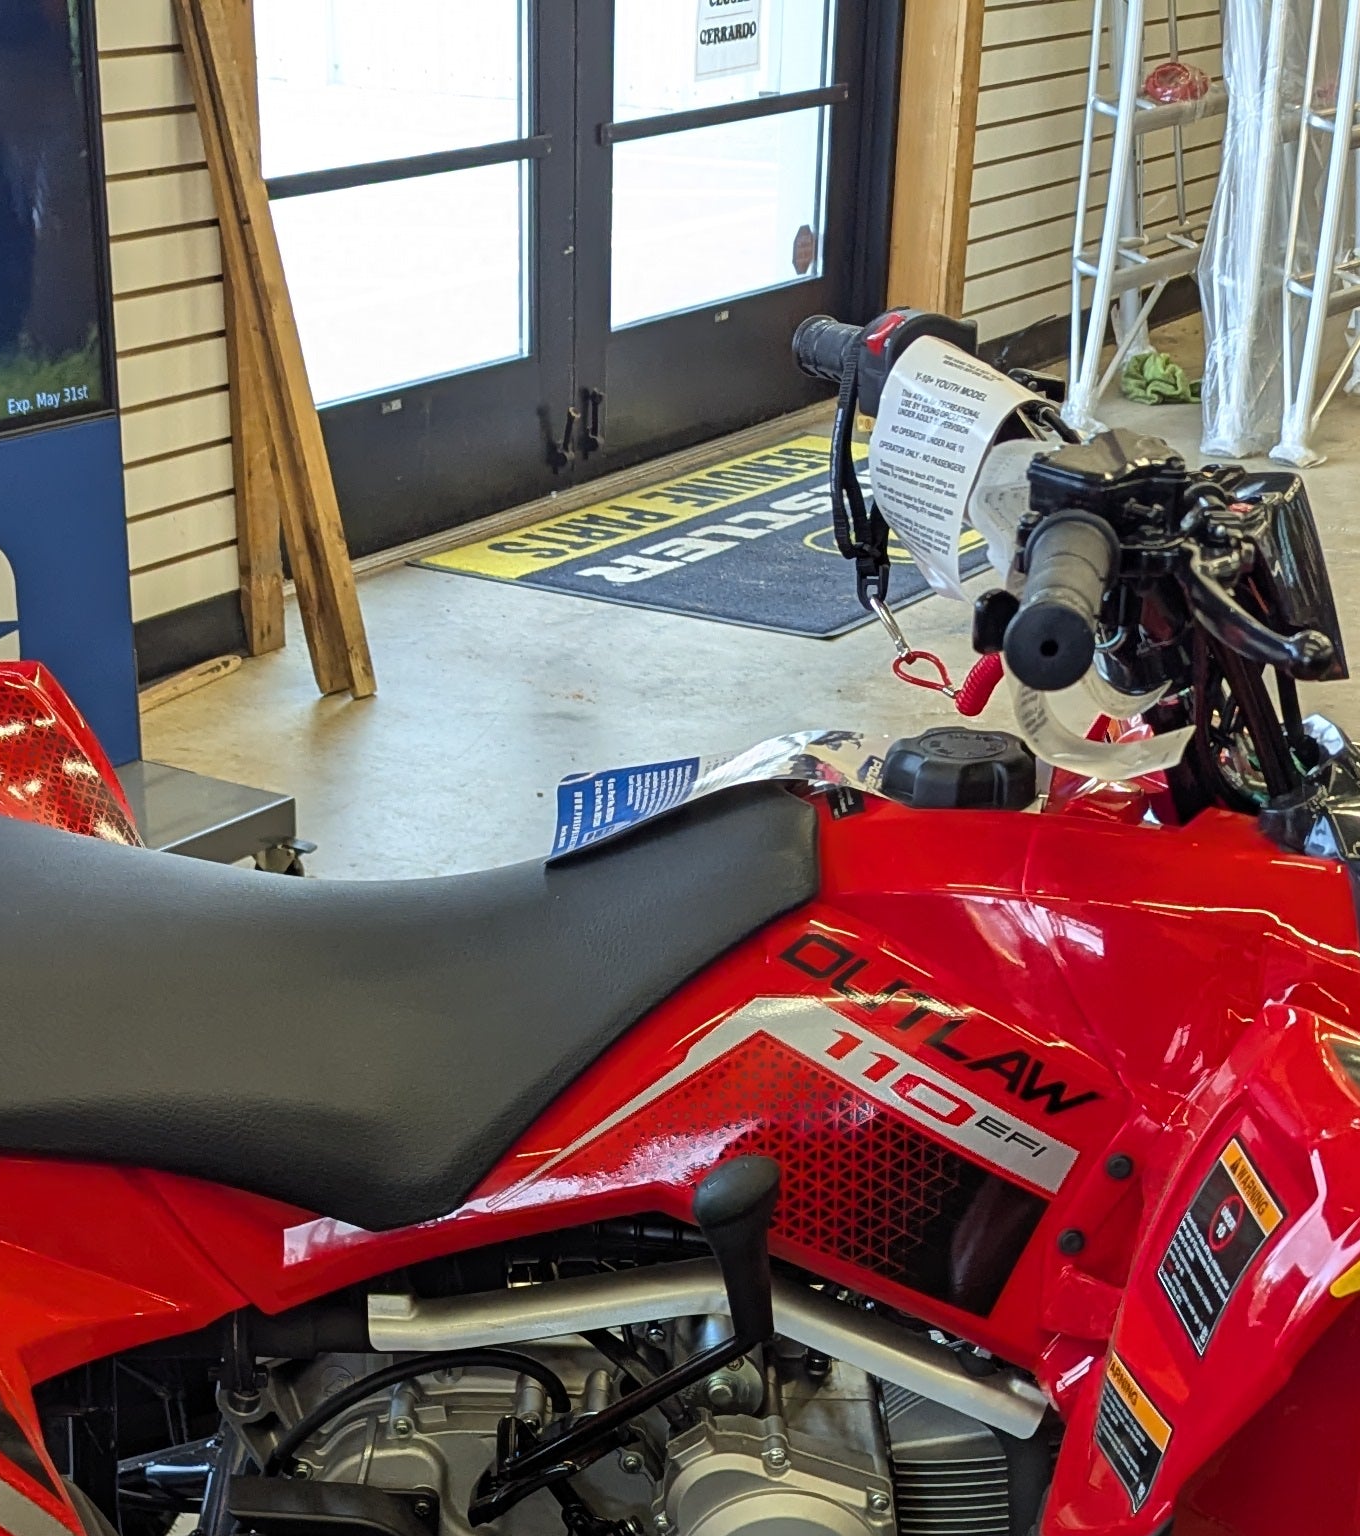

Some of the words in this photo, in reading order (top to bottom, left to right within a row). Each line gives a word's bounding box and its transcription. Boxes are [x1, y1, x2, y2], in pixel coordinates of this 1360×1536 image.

[7, 398, 34, 415] Exp.
[36, 392, 60, 408] May
[63, 384, 89, 403] 31st
[934, 378, 960, 393] YOUTH
[960, 386, 987, 401] MODEL
[644, 446, 829, 509] GENUINE
[487, 503, 676, 560] PARTS
[575, 482, 840, 584] STLER
[780, 932, 1105, 1115] OUTLAW
[825, 1027, 977, 1128] 110
[975, 1114, 1048, 1158] EFI
[1237, 1160, 1269, 1217] WARNING
[1109, 1361, 1138, 1407] ARNING
